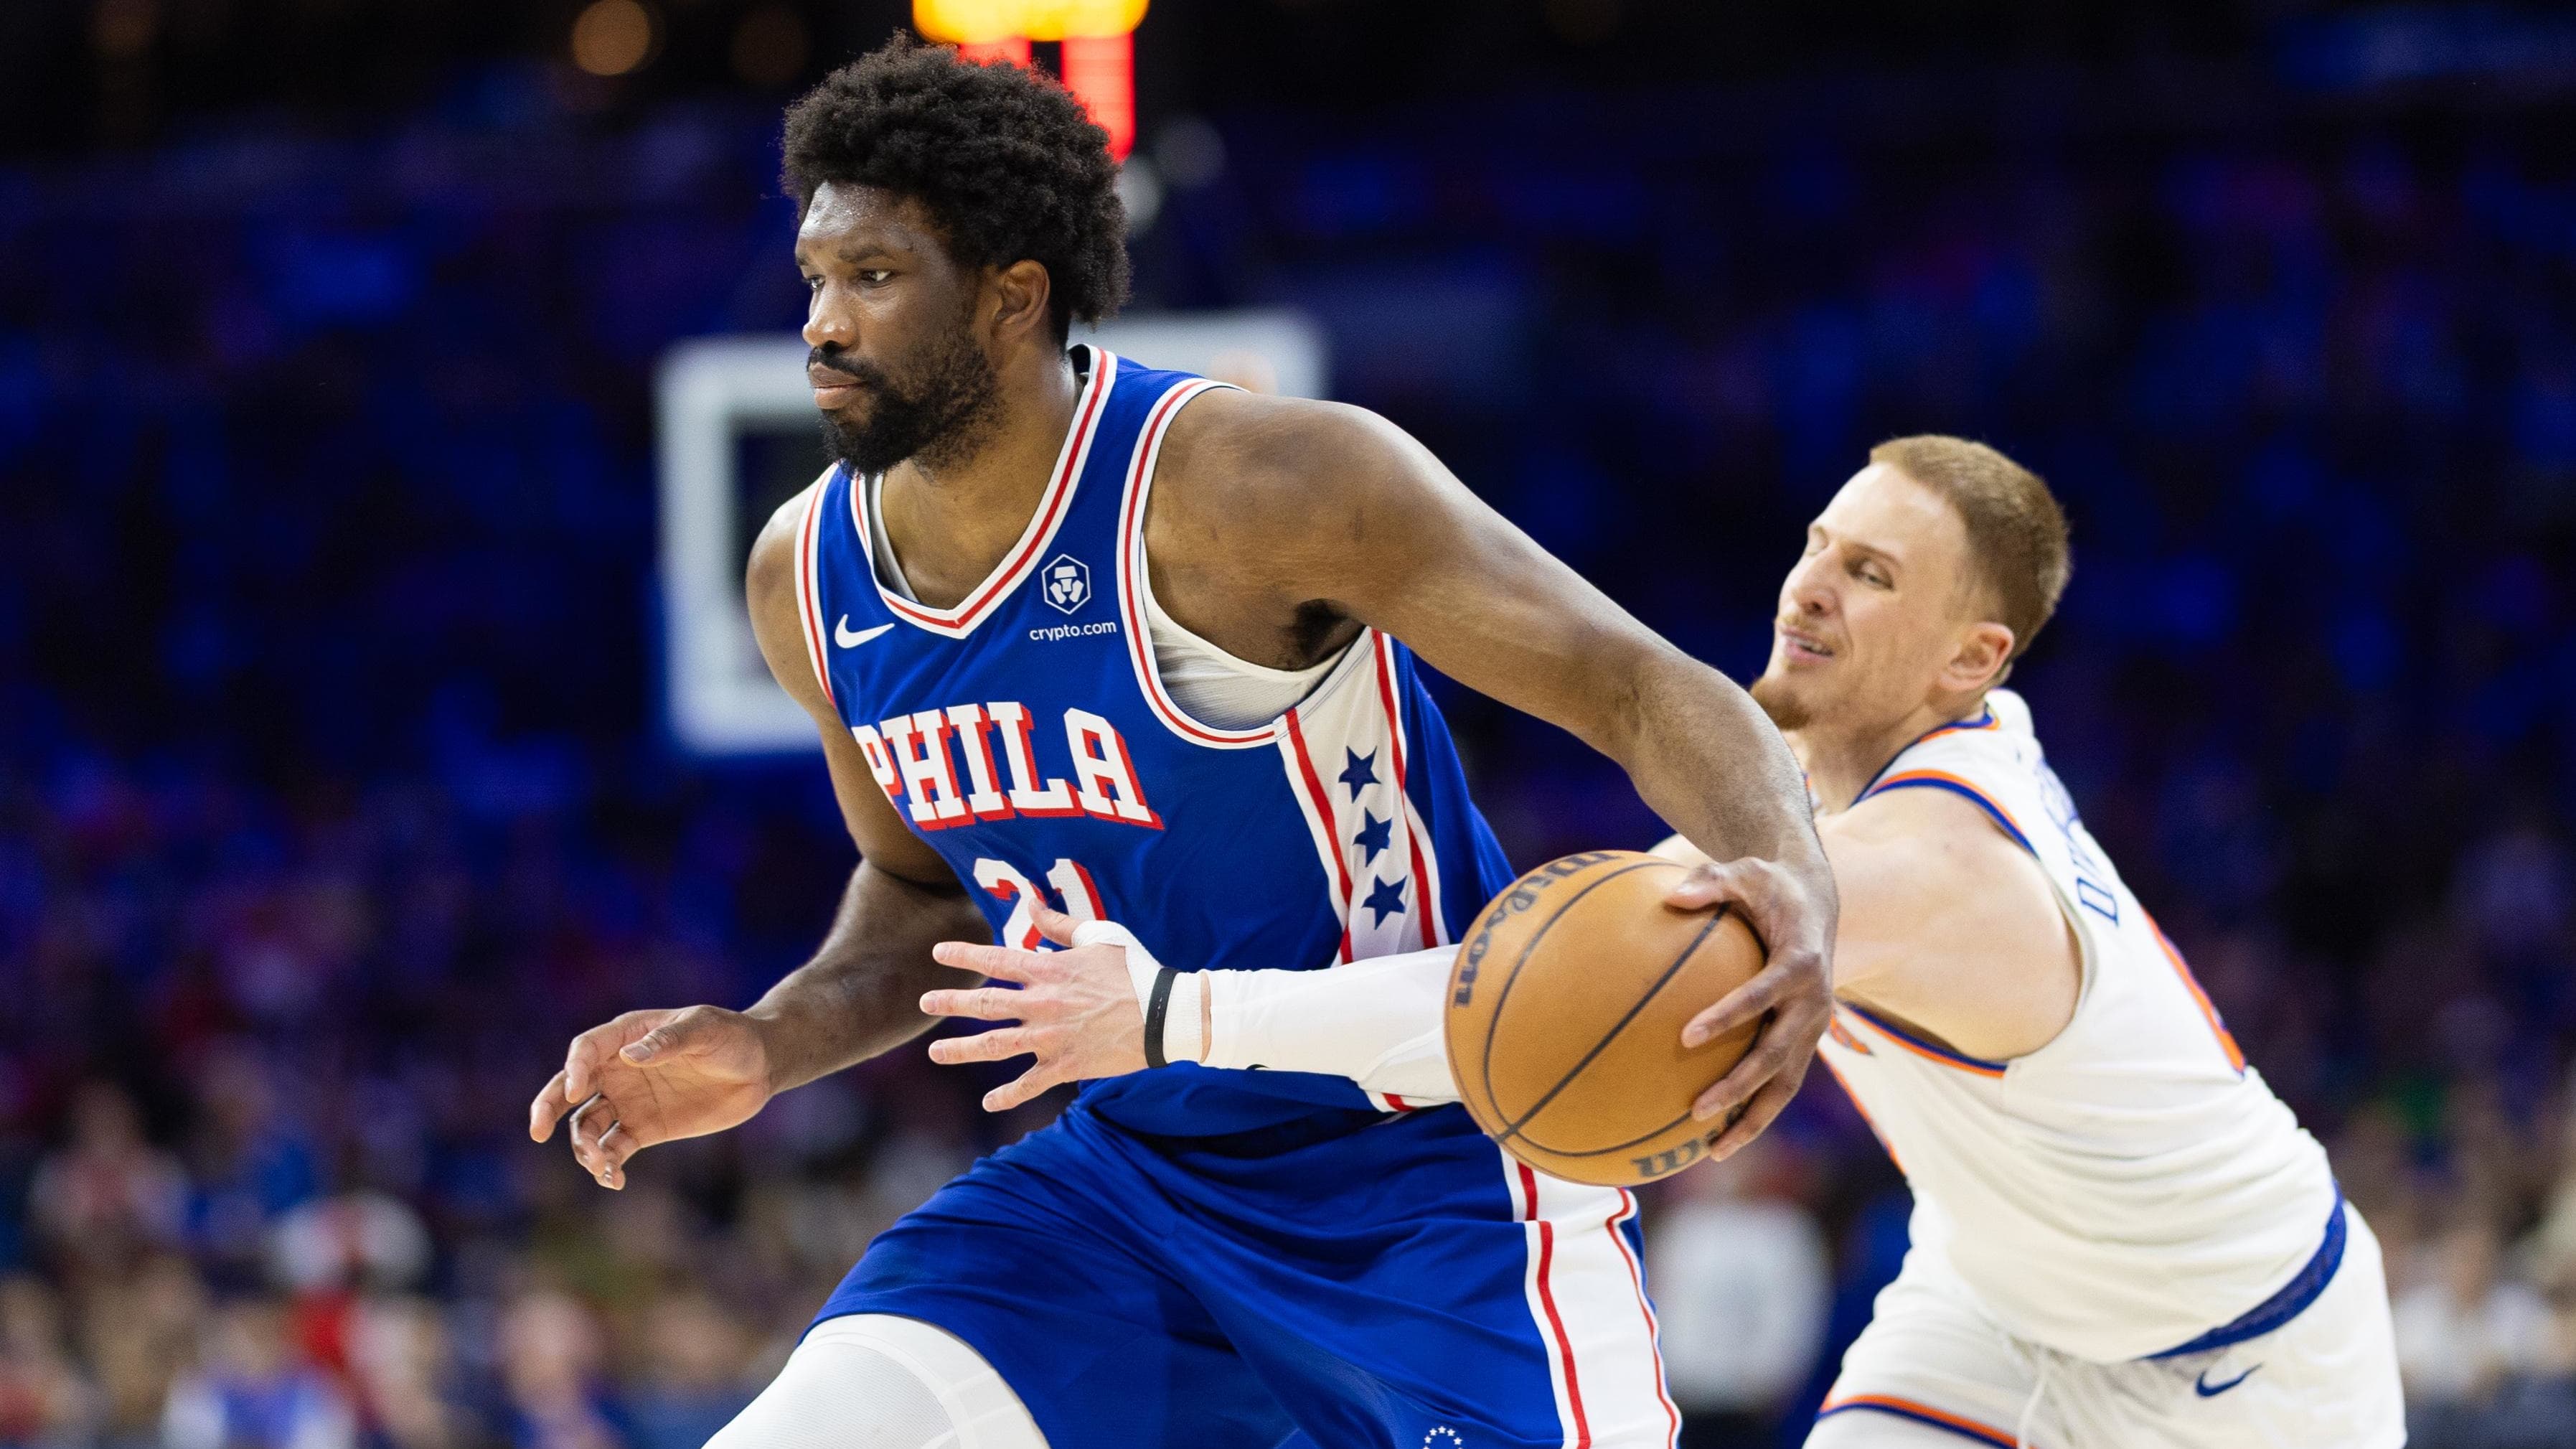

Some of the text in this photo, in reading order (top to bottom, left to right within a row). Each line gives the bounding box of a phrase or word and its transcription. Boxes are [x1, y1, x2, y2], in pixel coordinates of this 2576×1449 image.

[1030, 621, 1117, 642] crypto.com
[852, 701, 1165, 831] PHILA
[973, 857, 1108, 952] 21
